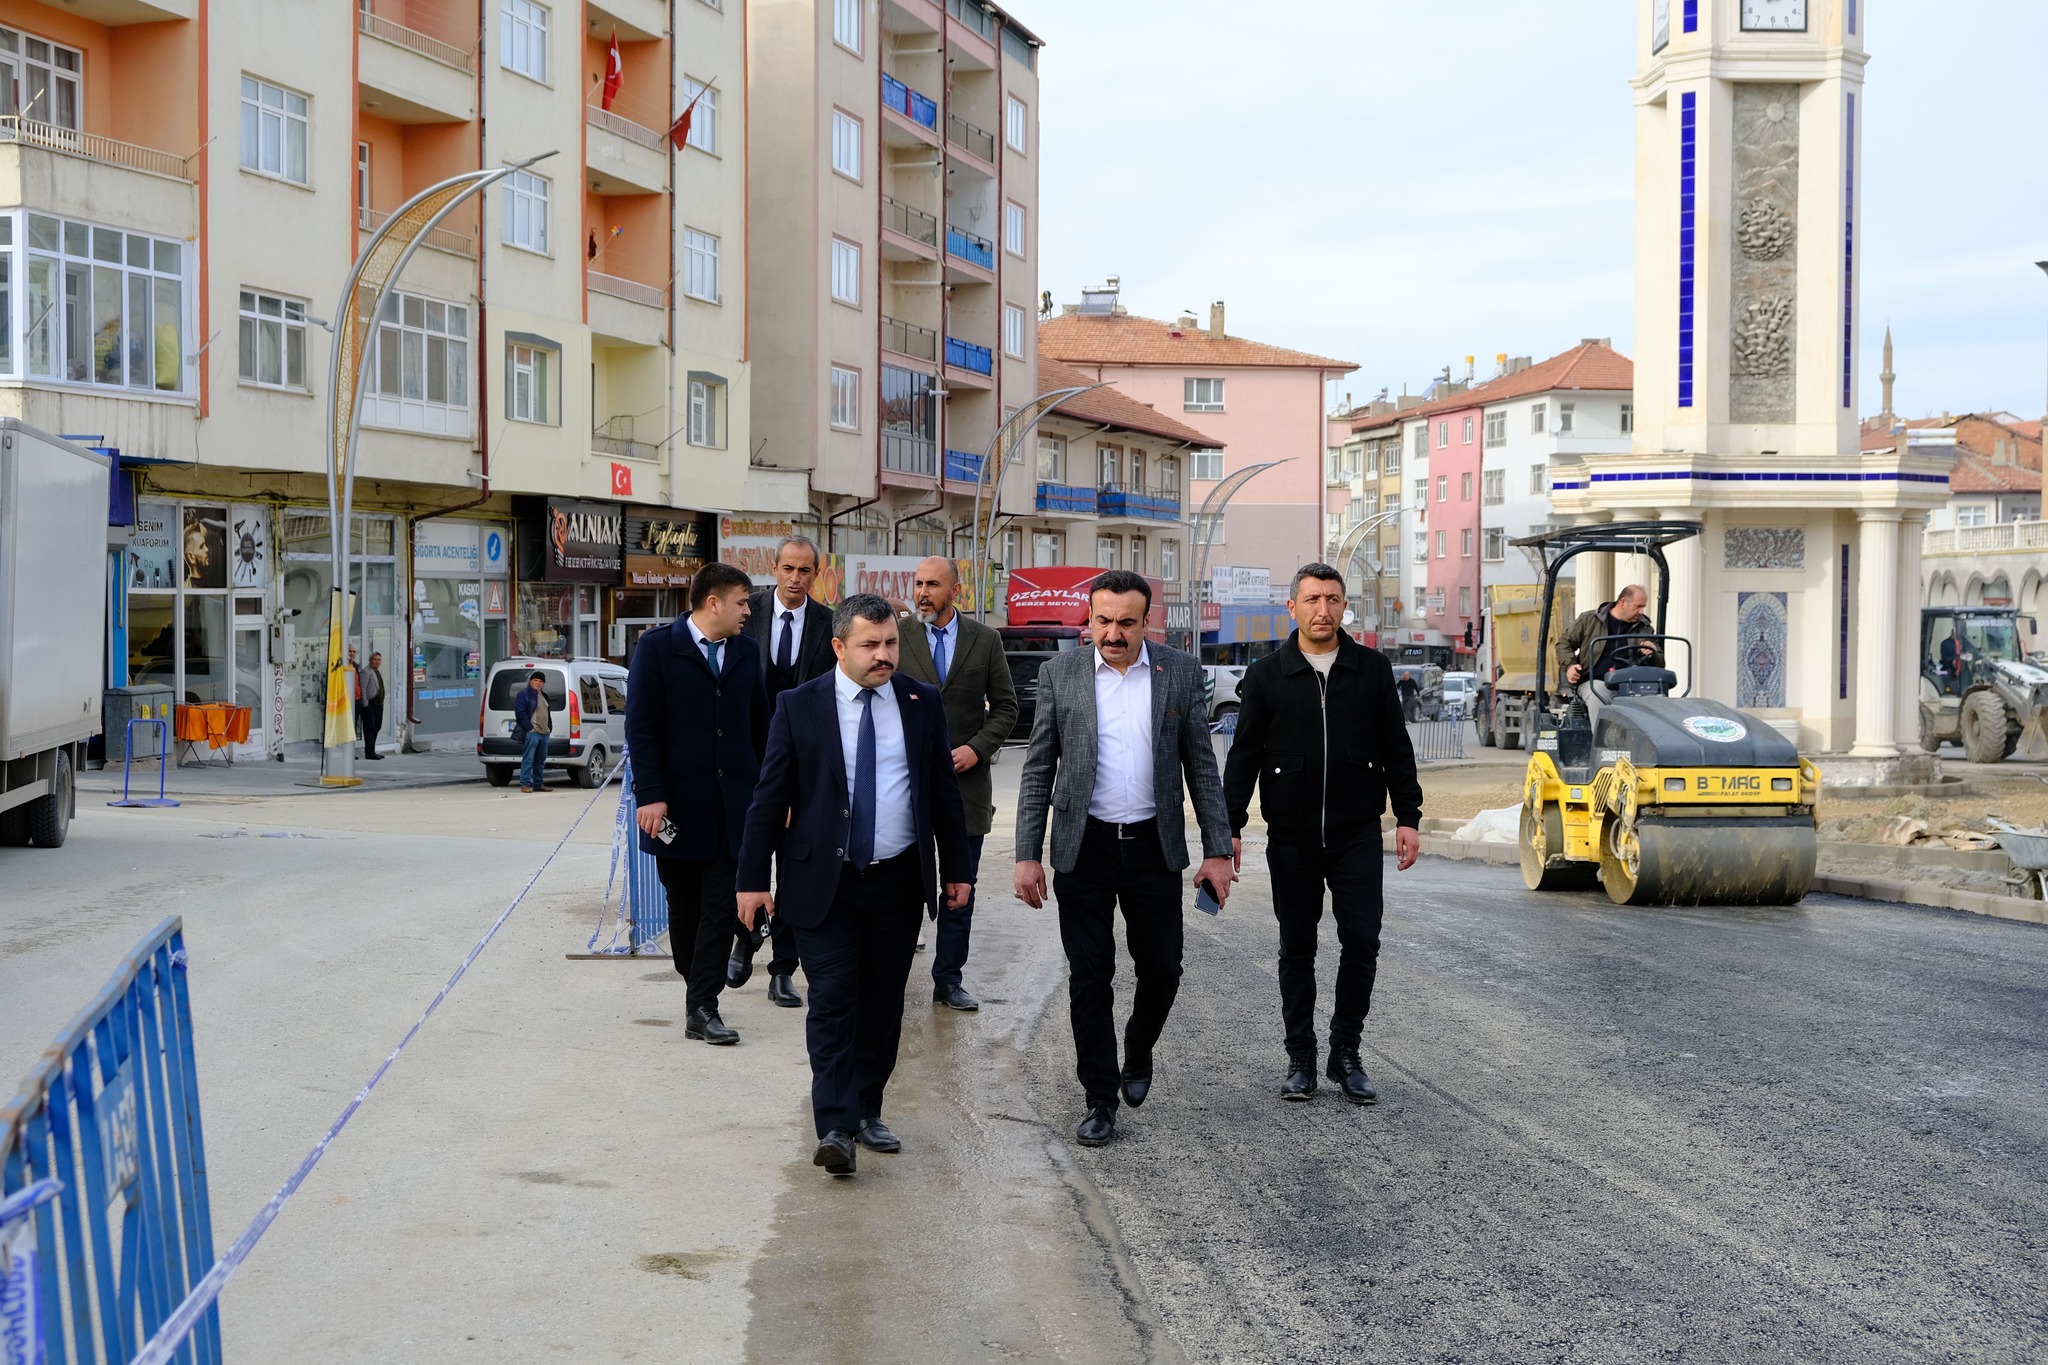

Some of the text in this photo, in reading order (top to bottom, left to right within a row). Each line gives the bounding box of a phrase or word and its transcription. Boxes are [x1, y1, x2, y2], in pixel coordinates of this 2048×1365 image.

[1770, 15, 1776, 23] 6
[1784, 15, 1789, 23] 5
[132, 536, 169, 548] KUAFÖRÜM
[721, 546, 777, 577] PASTAN
[458, 583, 480, 596] KASKO
[1010, 589, 1090, 602] ÖZÇAYLAR
[1201, 606, 1220, 617] RKET
[274, 663, 284, 735] AFOR
[1697, 775, 1761, 790] BMAG
